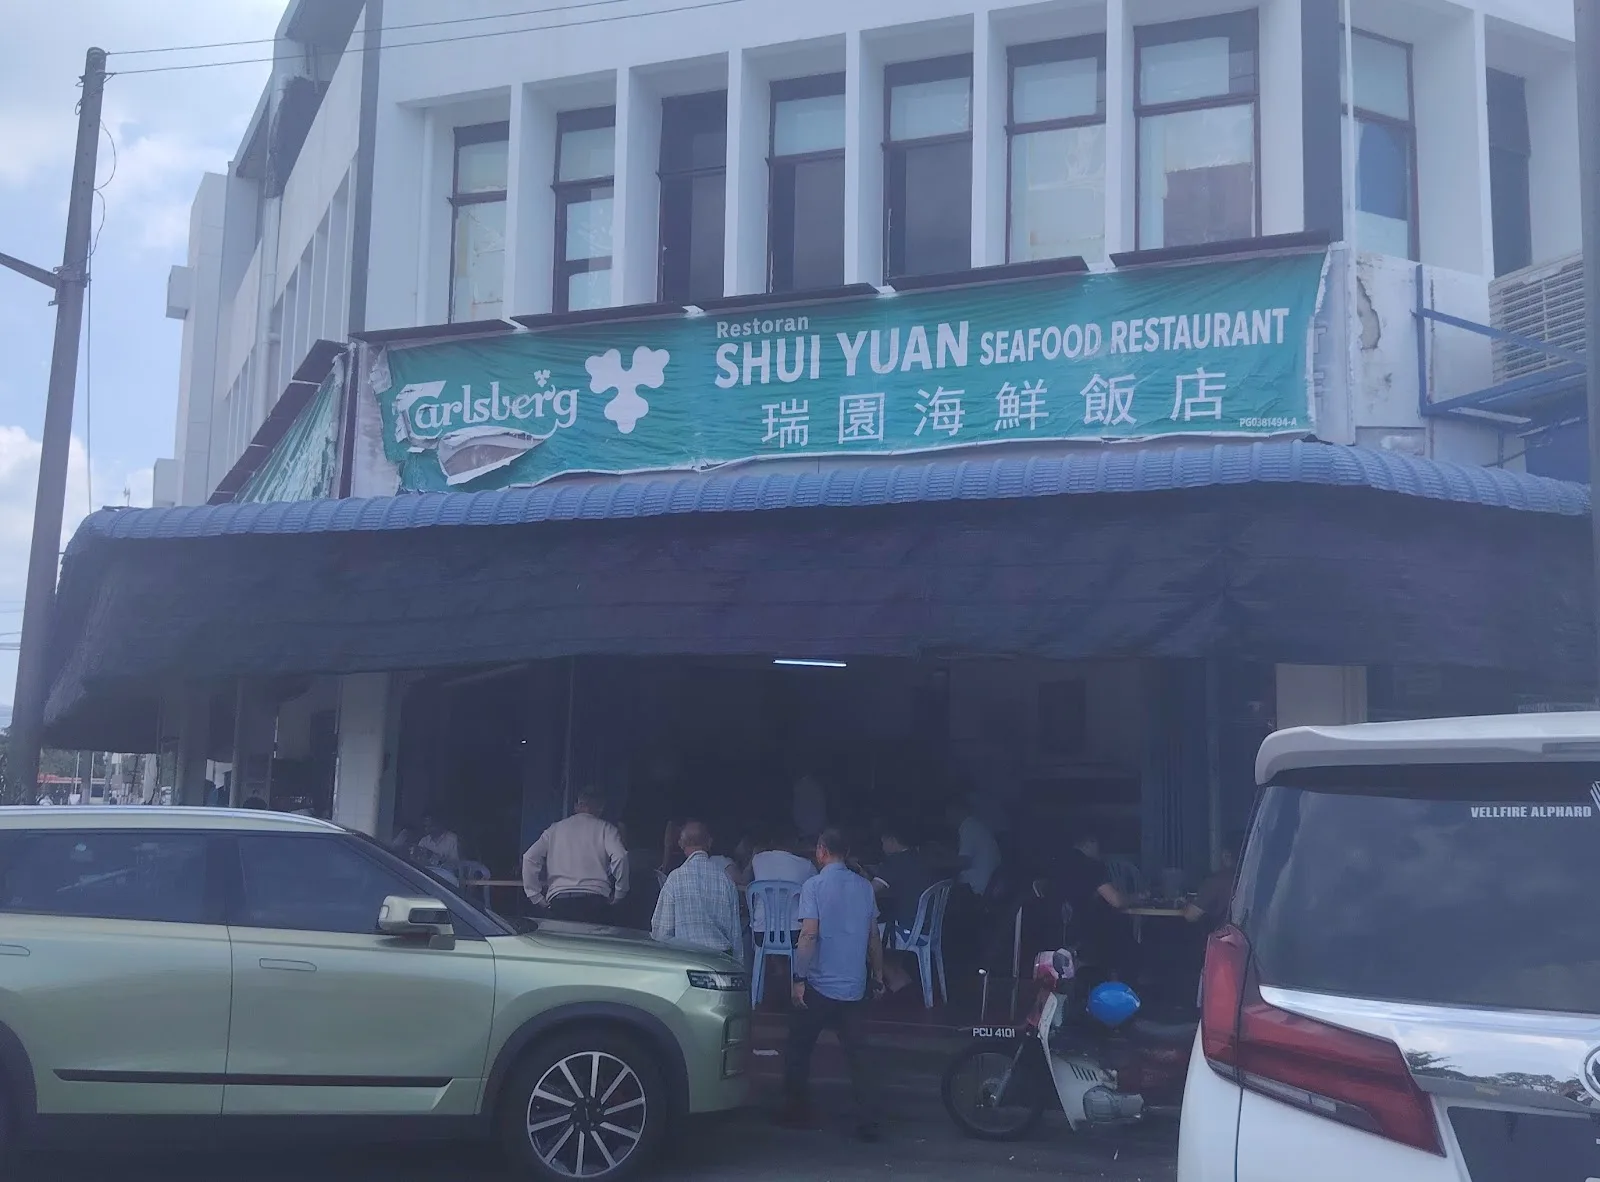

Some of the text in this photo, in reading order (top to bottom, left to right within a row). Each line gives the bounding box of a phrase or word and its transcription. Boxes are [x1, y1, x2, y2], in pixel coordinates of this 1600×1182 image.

[716, 316, 809, 339] Restoran
[714, 307, 1290, 388] SHUI YUAN SEAFOOD RESTAURANT
[761, 367, 1227, 448] 瑞園海鮮飯店
[1470, 806, 1592, 818] VELLFIRE ALPHARD
[972, 1027, 1016, 1038] PCU 4101
